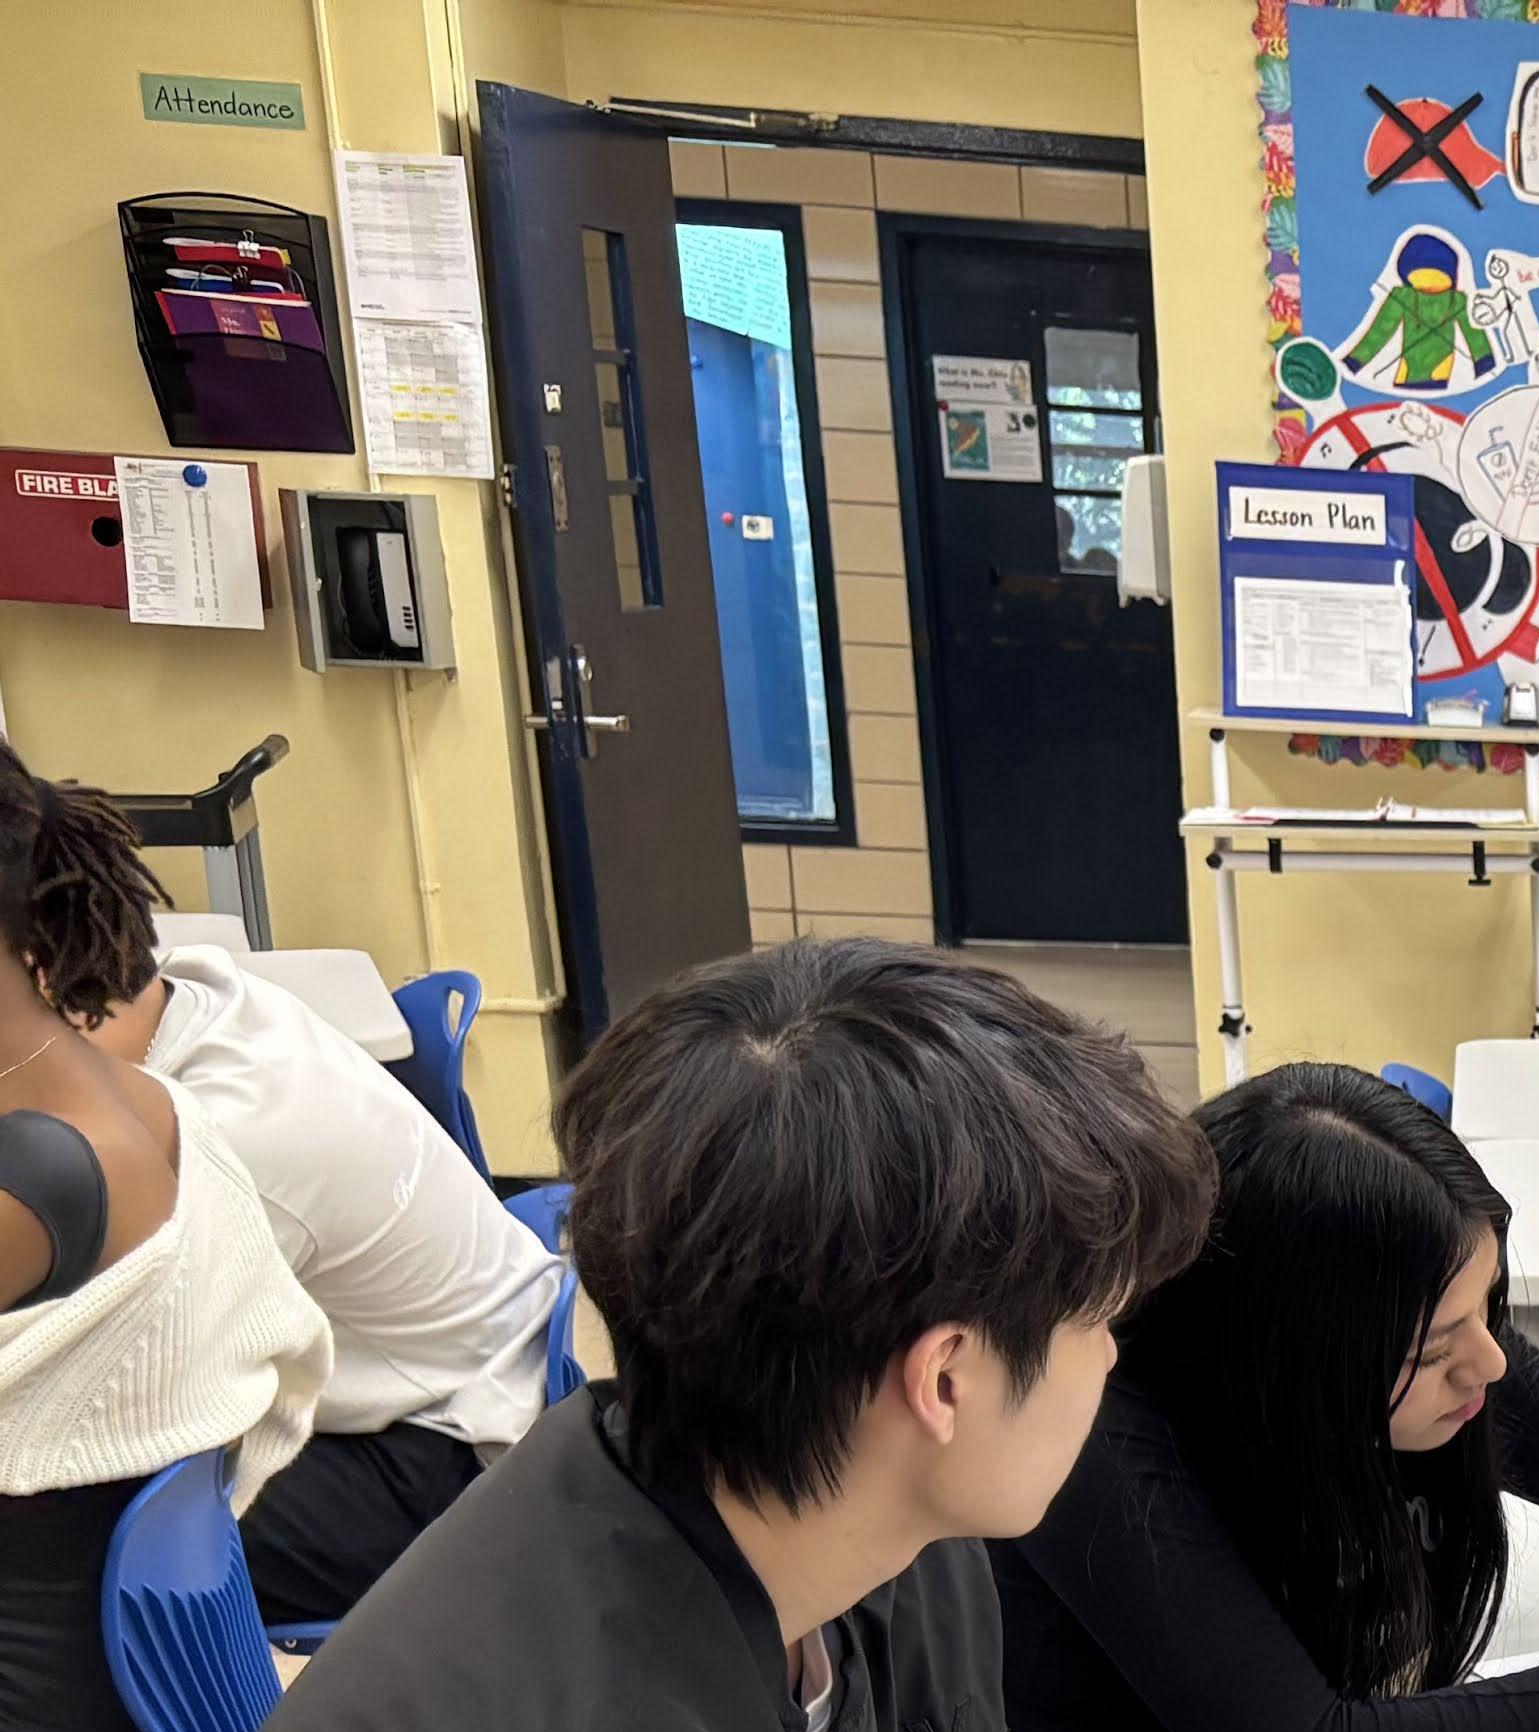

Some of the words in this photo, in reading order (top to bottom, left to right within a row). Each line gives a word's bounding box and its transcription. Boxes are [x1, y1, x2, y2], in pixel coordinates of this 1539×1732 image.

[154, 85, 295, 120] Attendance
[22, 473, 74, 495] FIRE
[1243, 496, 1314, 527] Lesson
[1327, 501, 1377, 532] Plan
